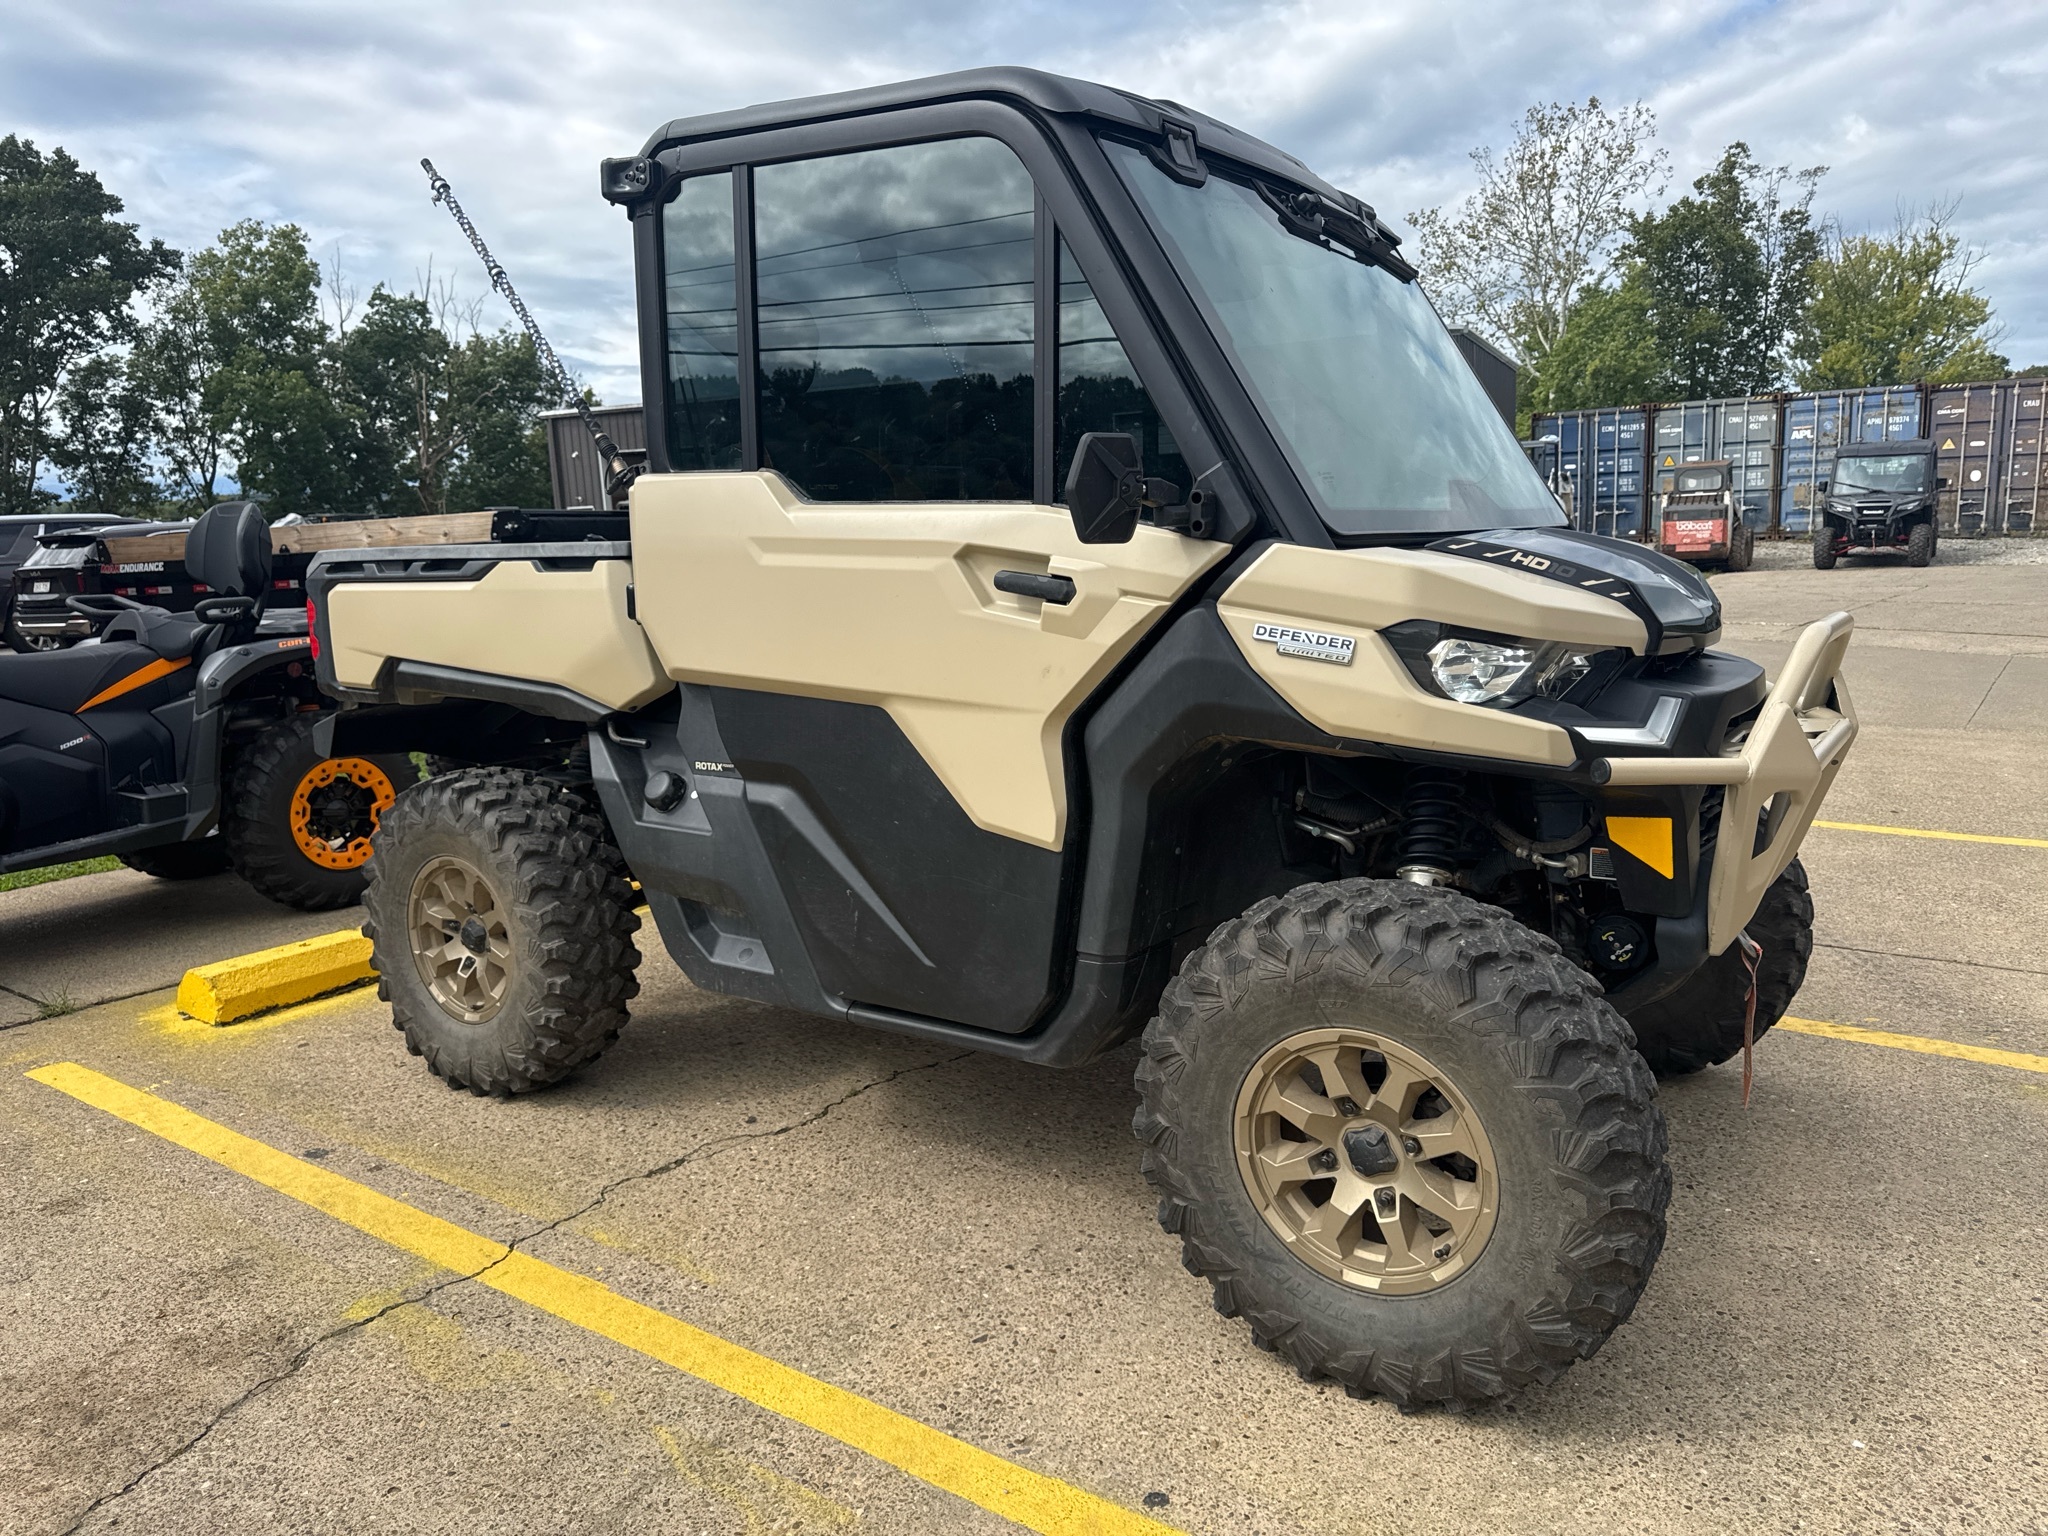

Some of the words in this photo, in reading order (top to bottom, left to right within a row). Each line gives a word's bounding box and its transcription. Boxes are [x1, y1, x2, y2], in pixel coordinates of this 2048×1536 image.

[1791, 429, 1814, 440] APL
[1676, 520, 1713, 531] bobcat
[1255, 625, 1353, 651] DEFENDER
[695, 761, 723, 772] ROTAX
